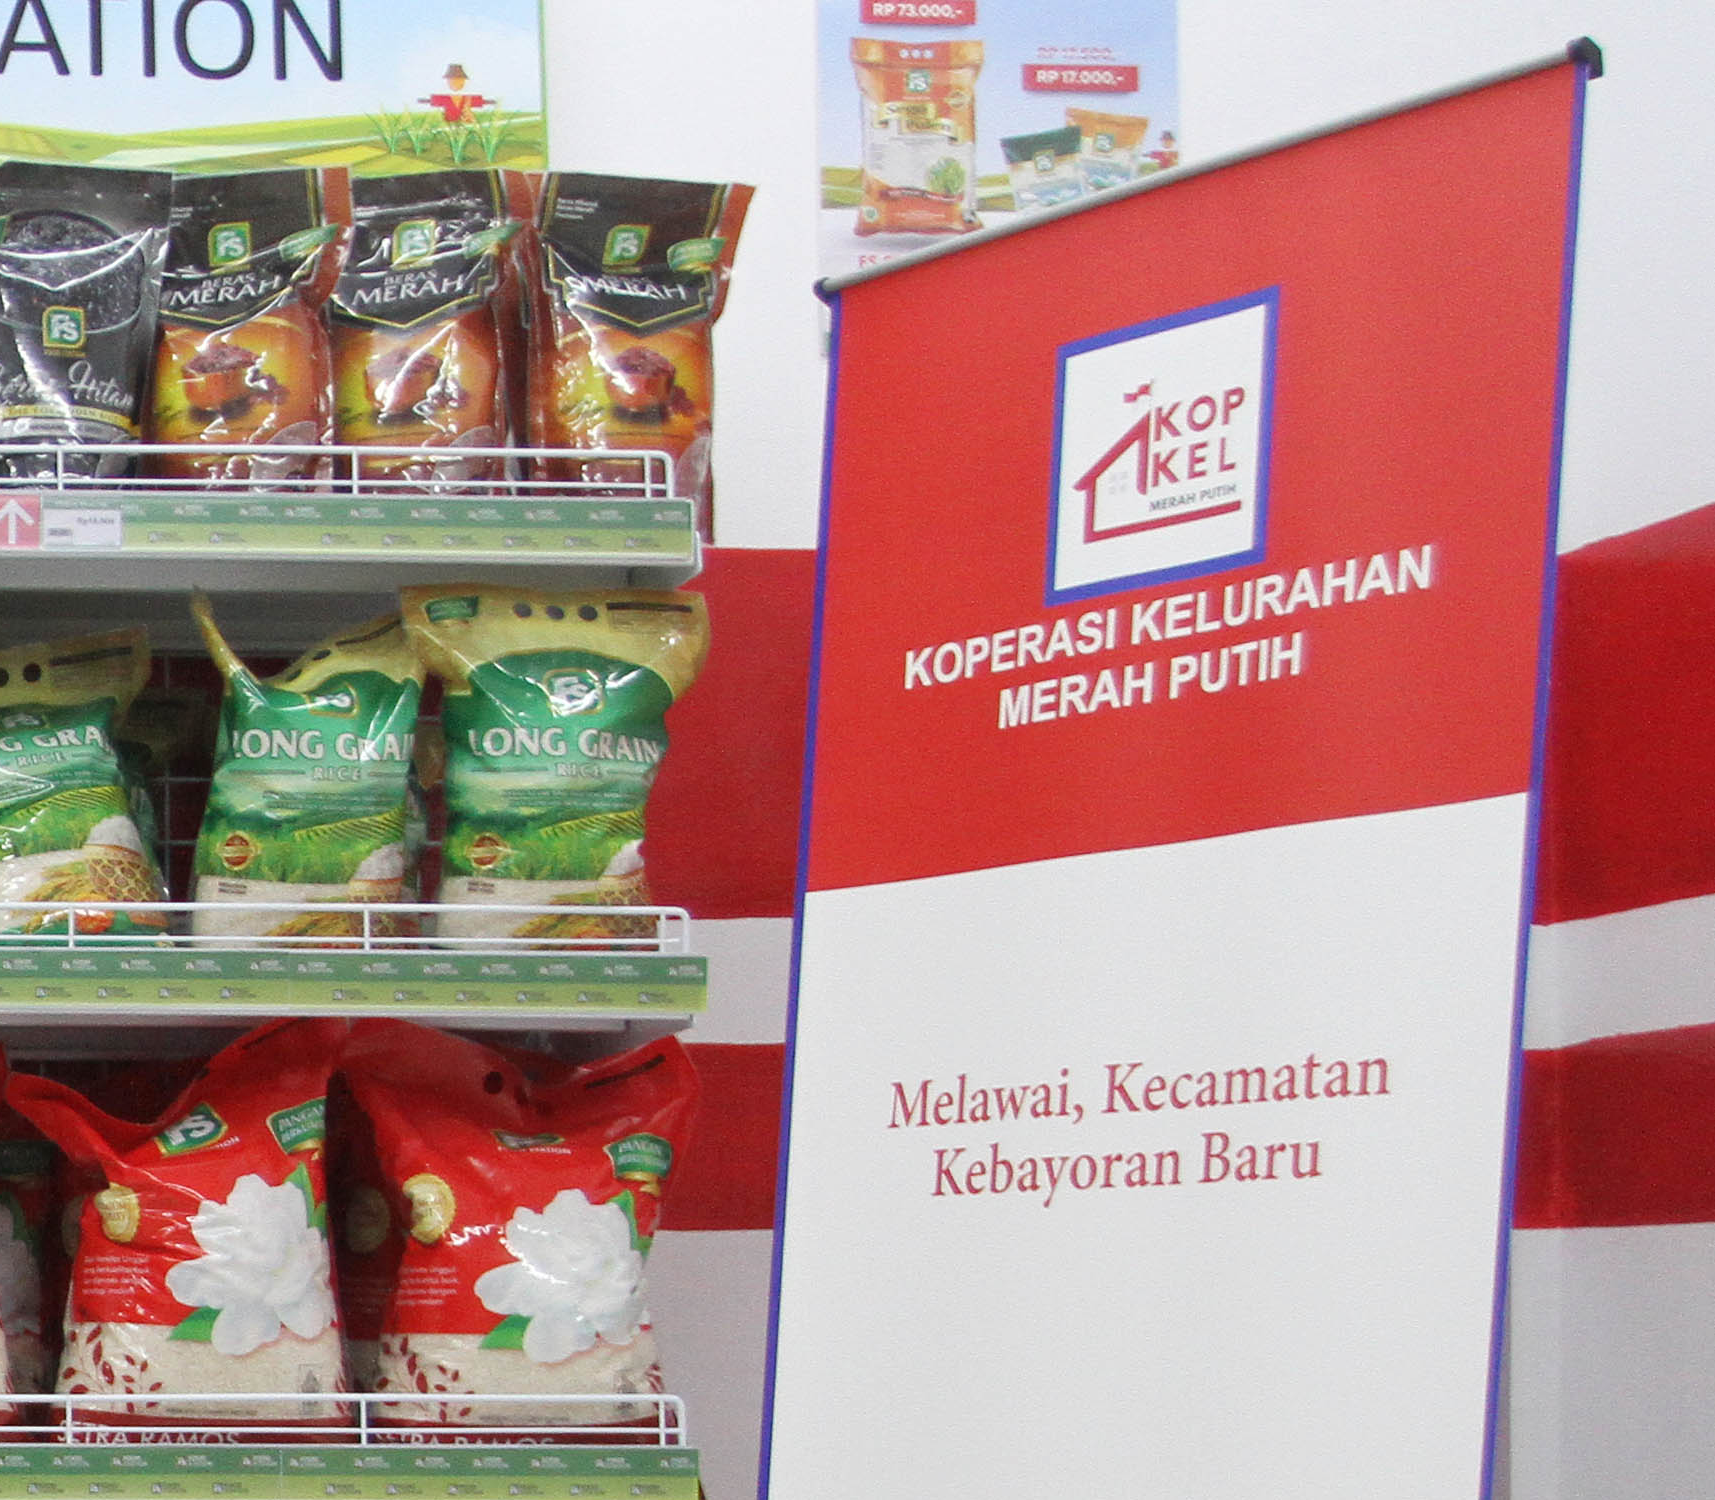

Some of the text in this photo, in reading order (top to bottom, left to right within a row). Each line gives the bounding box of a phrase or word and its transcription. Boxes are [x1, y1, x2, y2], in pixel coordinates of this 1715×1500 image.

[872, 3, 897, 18] RP
[1036, 70, 1060, 84] RP
[170, 275, 282, 306] MERAH
[352, 274, 466, 307] MERAH
[1152, 386, 1246, 443] KOP
[1151, 440, 1238, 489] KEL
[1149, 482, 1238, 513] MERAH PUTIH
[903, 545, 1434, 690] KOPERASI KELURAHAN
[998, 632, 1306, 730] MERAH PUTIH
[30, 724, 116, 752] GRAI
[232, 728, 324, 760] LONG
[468, 727, 663, 764] LONG GRAIN
[886, 1052, 1392, 1129] Melawai, Kecamatan
[931, 1131, 1323, 1208] Kebayoran Baru
